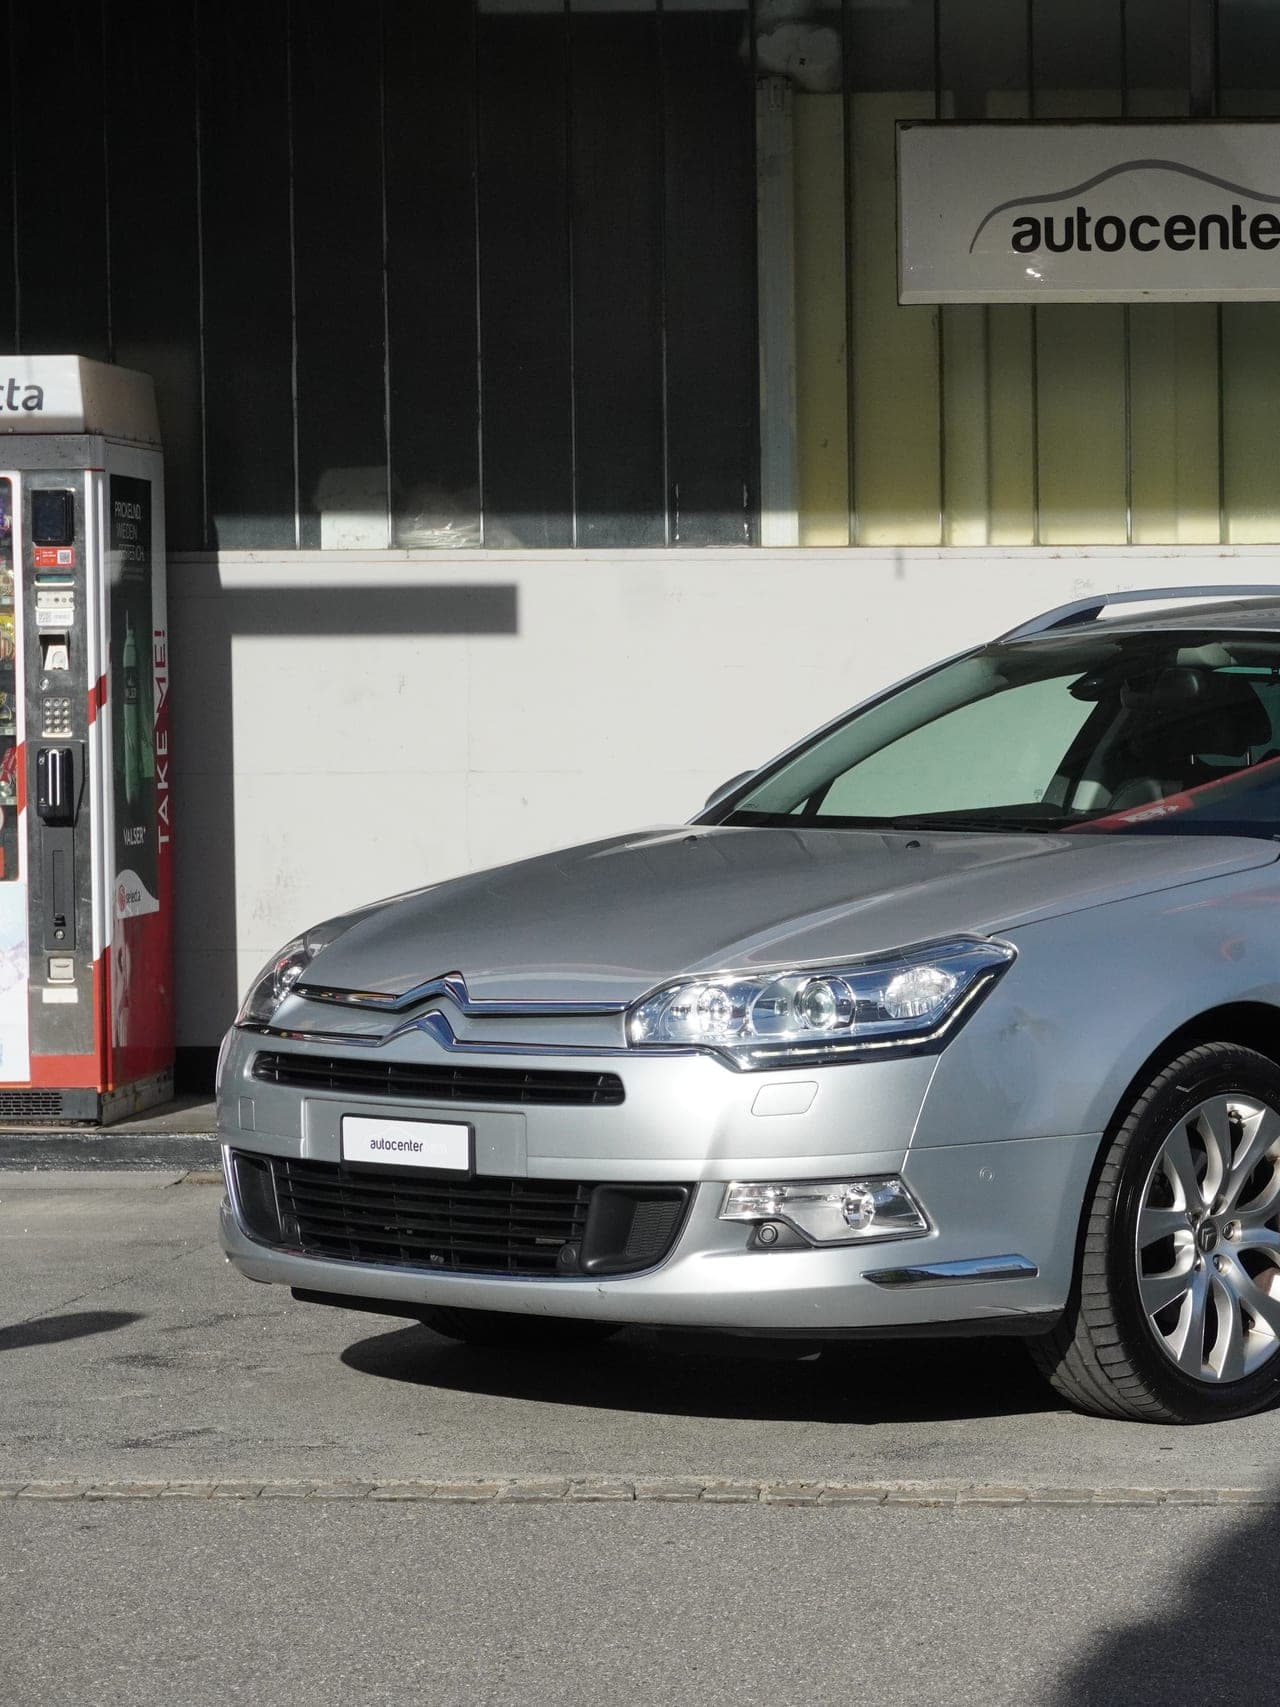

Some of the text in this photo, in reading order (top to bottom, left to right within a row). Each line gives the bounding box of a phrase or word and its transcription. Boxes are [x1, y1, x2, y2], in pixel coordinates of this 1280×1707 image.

[0, 377, 44, 411] ta
[156, 729, 170, 855] TAKE
[370, 1137, 424, 1153] autocenter
